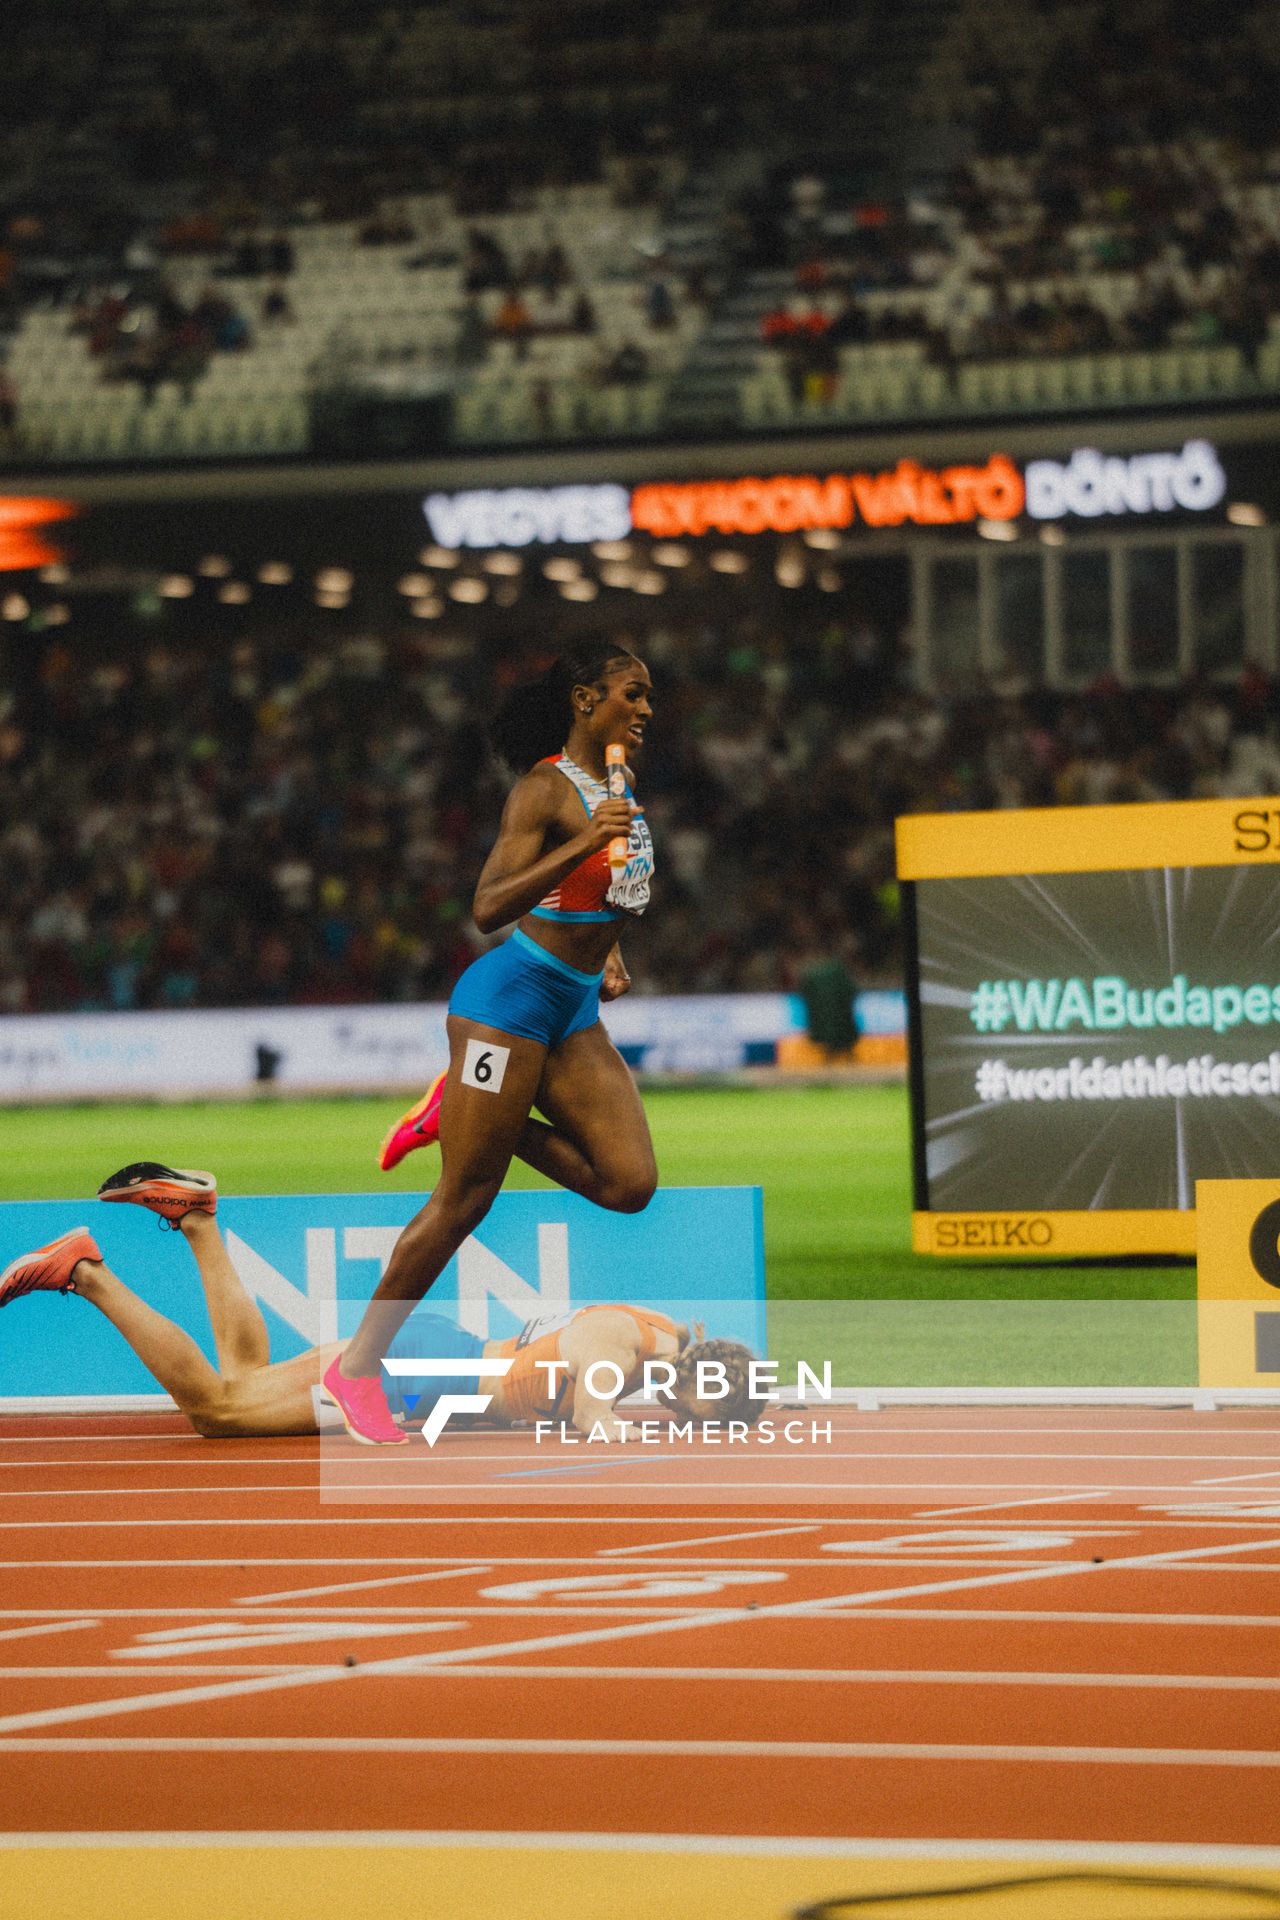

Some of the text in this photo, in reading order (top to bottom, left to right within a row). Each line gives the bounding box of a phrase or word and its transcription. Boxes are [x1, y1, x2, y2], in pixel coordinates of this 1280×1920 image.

[1234, 811, 1280, 852] S
[474, 1051, 492, 1084] 6
[936, 1219, 1052, 1246] SEIKO
[226, 1222, 570, 1345] NTN
